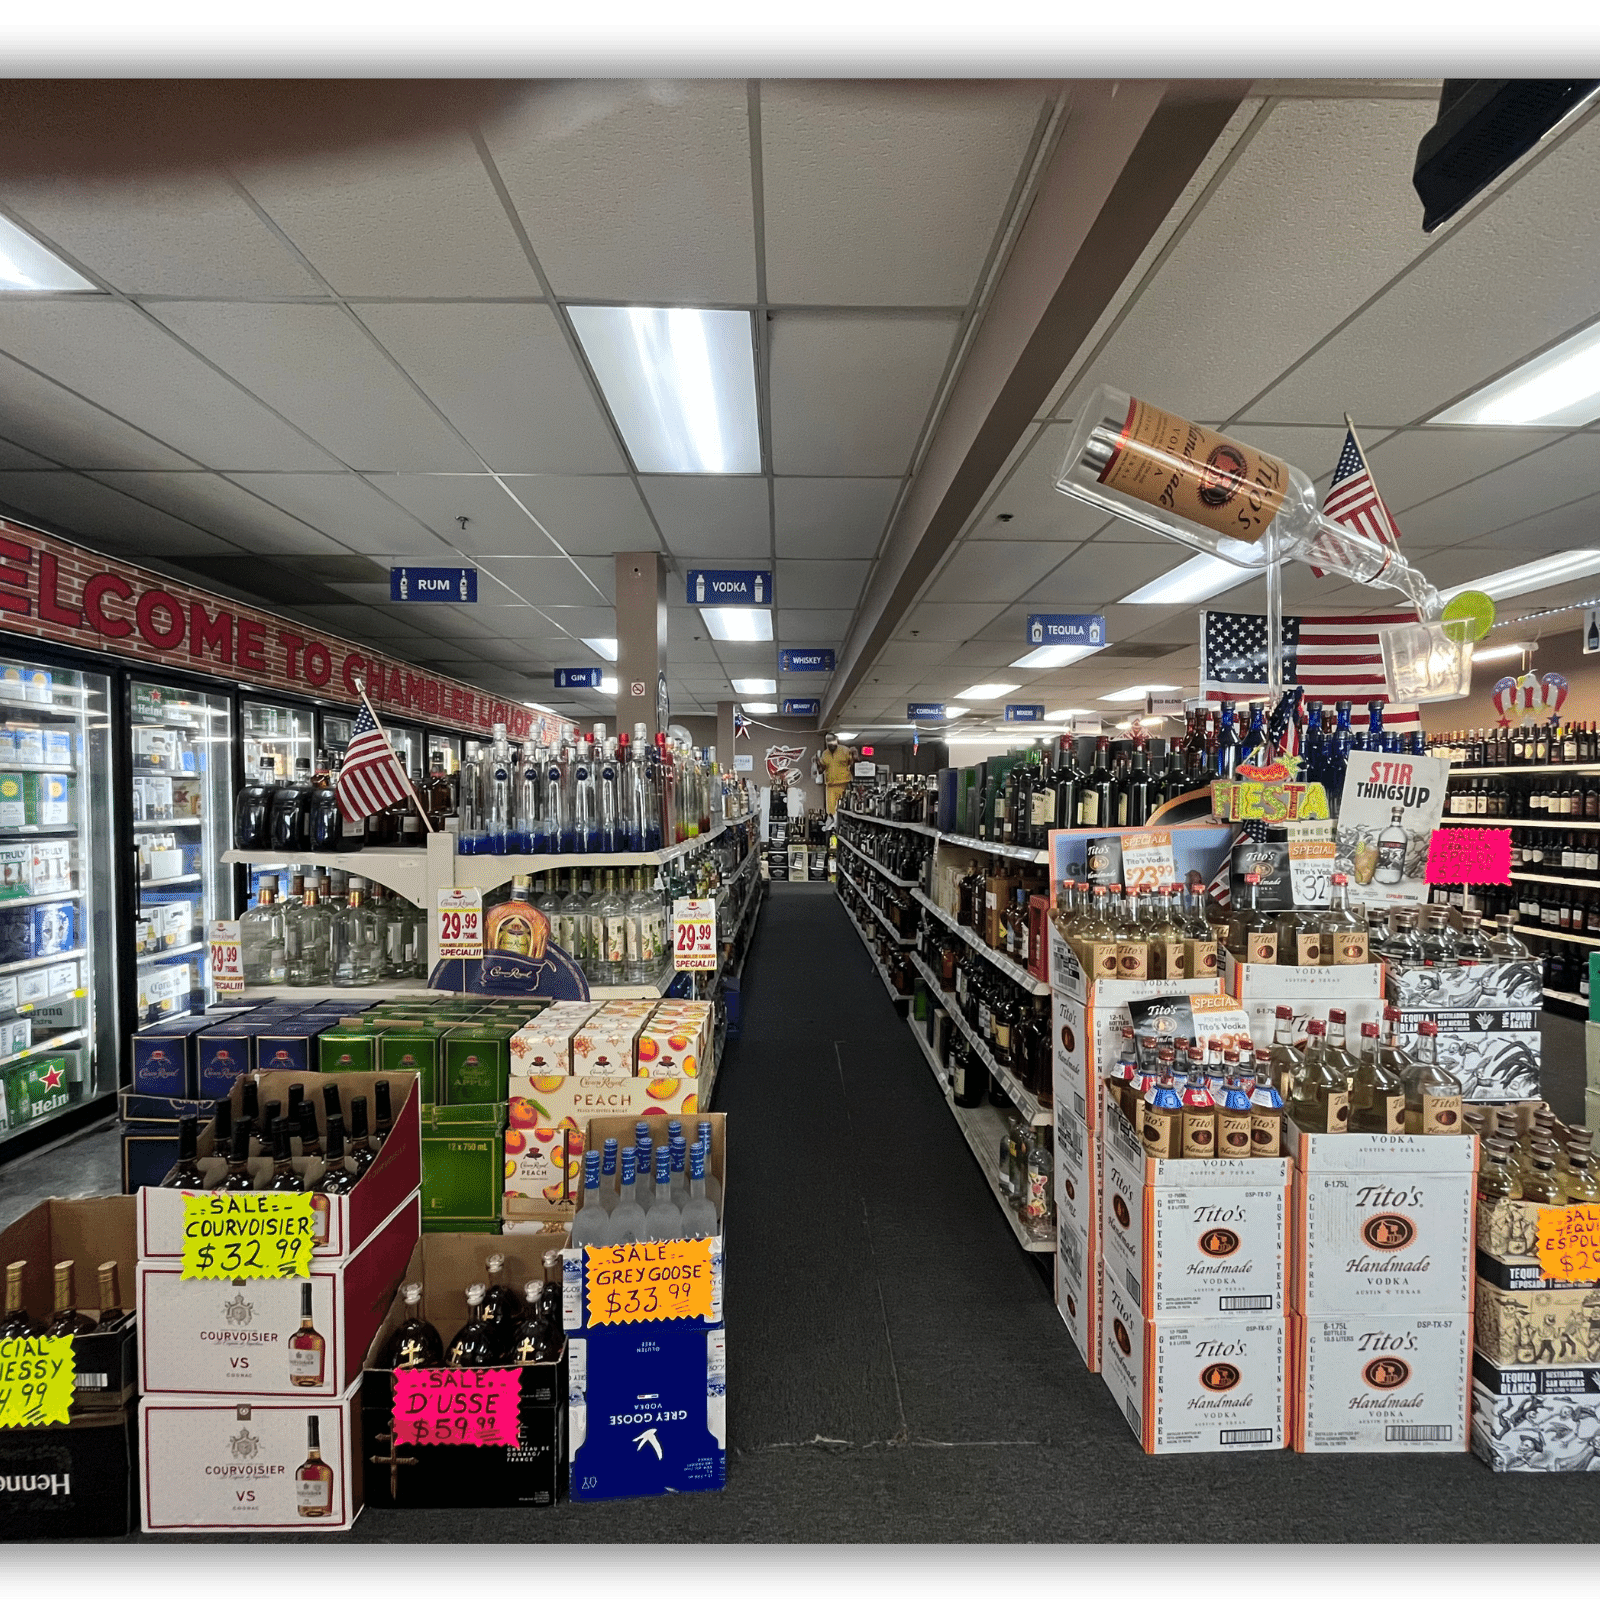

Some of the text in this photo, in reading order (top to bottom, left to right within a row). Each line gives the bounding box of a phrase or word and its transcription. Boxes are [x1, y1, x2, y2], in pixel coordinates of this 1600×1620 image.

[418, 579, 450, 591] RUM
[712, 581, 747, 593] VODKA
[1048, 625, 1084, 636] TEQUILA
[793, 656, 821, 665] WHISKEY
[280, 631, 332, 687] TO
[343, 653, 474, 724] CHAMBLEE
[571, 674, 586, 682] GIN
[1369, 761, 1414, 786] STIR
[1211, 781, 1332, 823] FIESTA
[1357, 782, 1430, 808] THINGS UP
[0, 850, 27, 861] TRULY
[1246, 851, 1276, 862] Tito's
[1292, 845, 1336, 857] SPECIAL
[442, 912, 478, 940] 29.99
[677, 924, 712, 951] 29.99
[1193, 997, 1239, 1010] SPECIAL
[574, 1094, 632, 1106] PEACH
[1371, 1136, 1415, 1144] VODKA
[1355, 1184, 1425, 1209] Tito's
[1193, 1204, 1248, 1223] Tito's
[1308, 1193, 1316, 1249] GLUTEN
[185, 1216, 311, 1239] COURVOISIER
[1107, 1217, 1137, 1260] Handmade
[1460, 1188, 1469, 1302] AUSTIN TEXAS
[612, 1246, 667, 1264] SALE
[1186, 1260, 1254, 1276] Handmade
[1345, 1255, 1431, 1273] Handmade
[596, 1264, 702, 1286] GREY GOOSE
[1367, 1277, 1409, 1286] VODKA
[1417, 1320, 1453, 1329] DSP-TX-57
[200, 1330, 279, 1343] COURVOISIER
[1356, 1330, 1419, 1352] Tito's
[229, 1357, 250, 1370] VS
[430, 1372, 486, 1391] SALE
[1501, 1371, 1537, 1383] TEQUILA
[1501, 1382, 1537, 1395] BLANCO
[406, 1393, 498, 1416] D'USSE
[1187, 1392, 1254, 1411] Handmade
[1348, 1392, 1424, 1411] Handmade
[609, 1409, 688, 1426] GREY GOOSE
[1203, 1411, 1237, 1419] VODKA
[205, 1464, 285, 1477] COURVOISIER
[236, 1490, 256, 1502] VS
